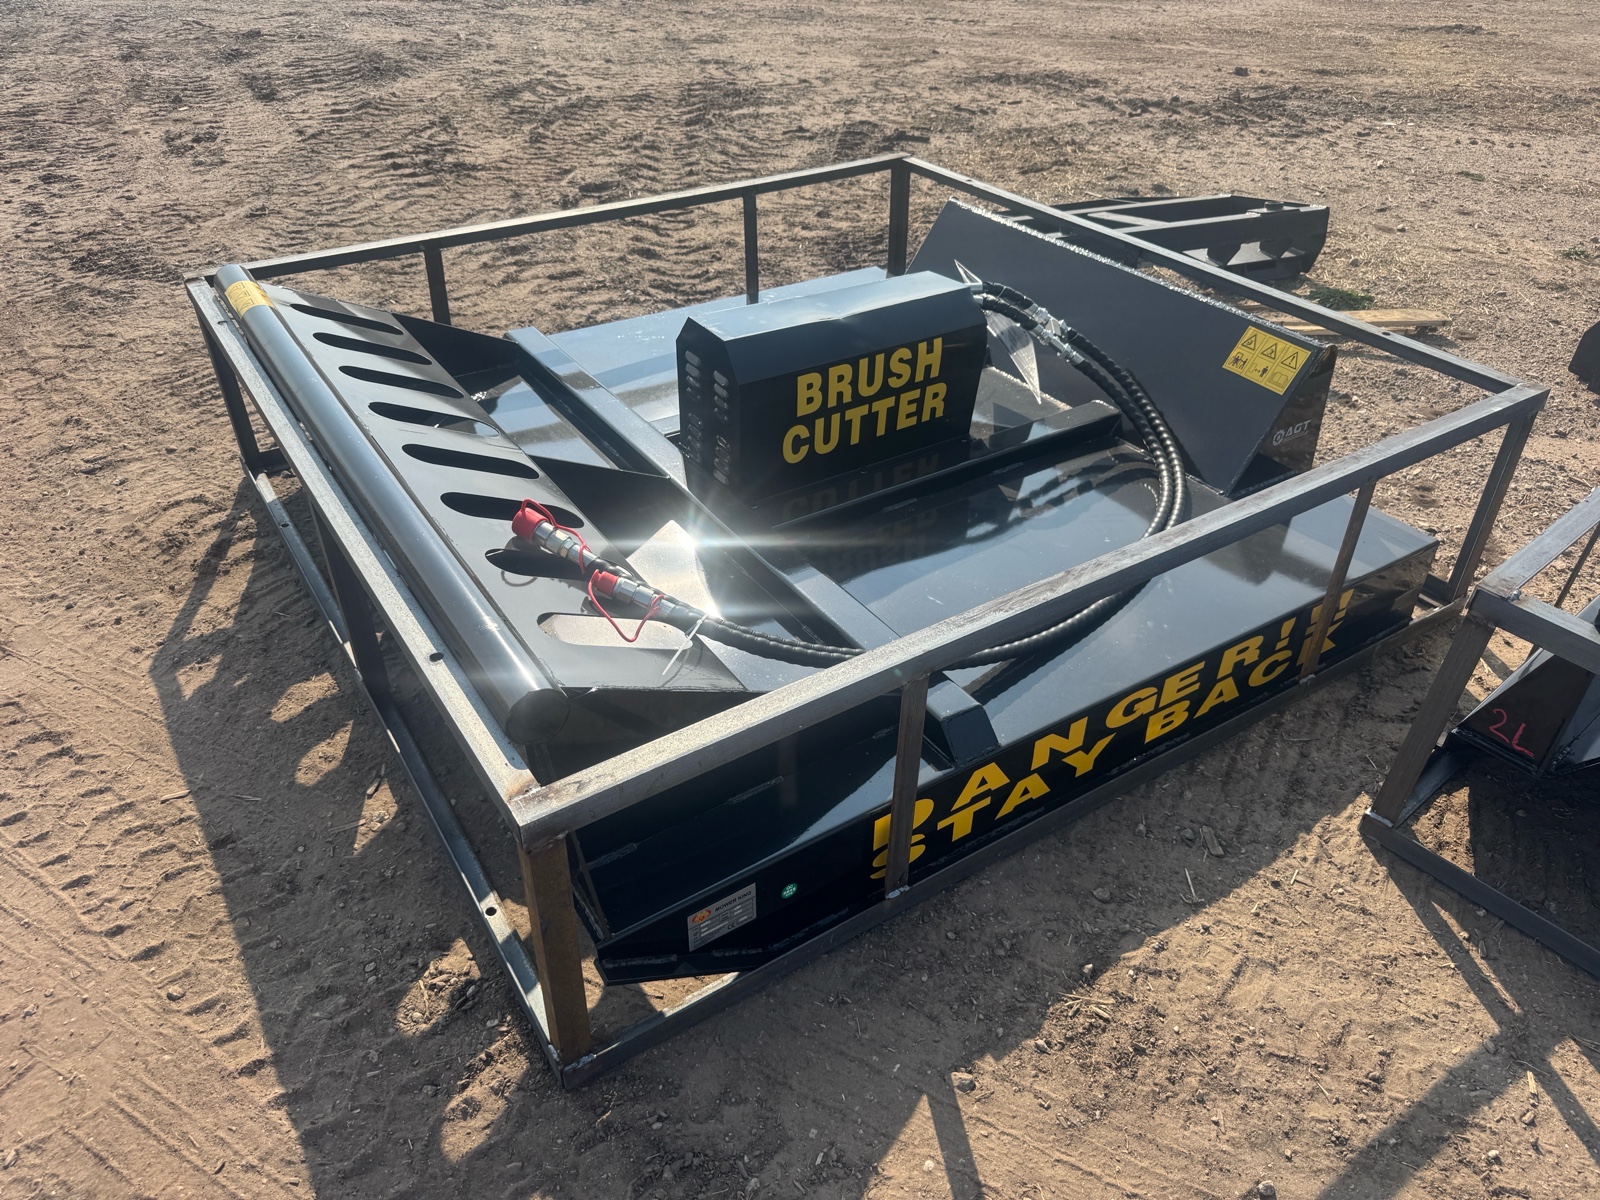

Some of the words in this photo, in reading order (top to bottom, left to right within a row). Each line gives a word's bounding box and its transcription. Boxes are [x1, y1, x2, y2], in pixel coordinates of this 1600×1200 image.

[796, 337, 943, 418] BRUSH
[782, 382, 947, 464] CUTTER
[1284, 420, 1311, 437] AGT
[869, 732, 1117, 880] STAY
[1144, 620, 1344, 745] BACK
[1488, 708, 1534, 759] 2L
[715, 898, 737, 912] MOWER
[738, 891, 752, 900] KING
